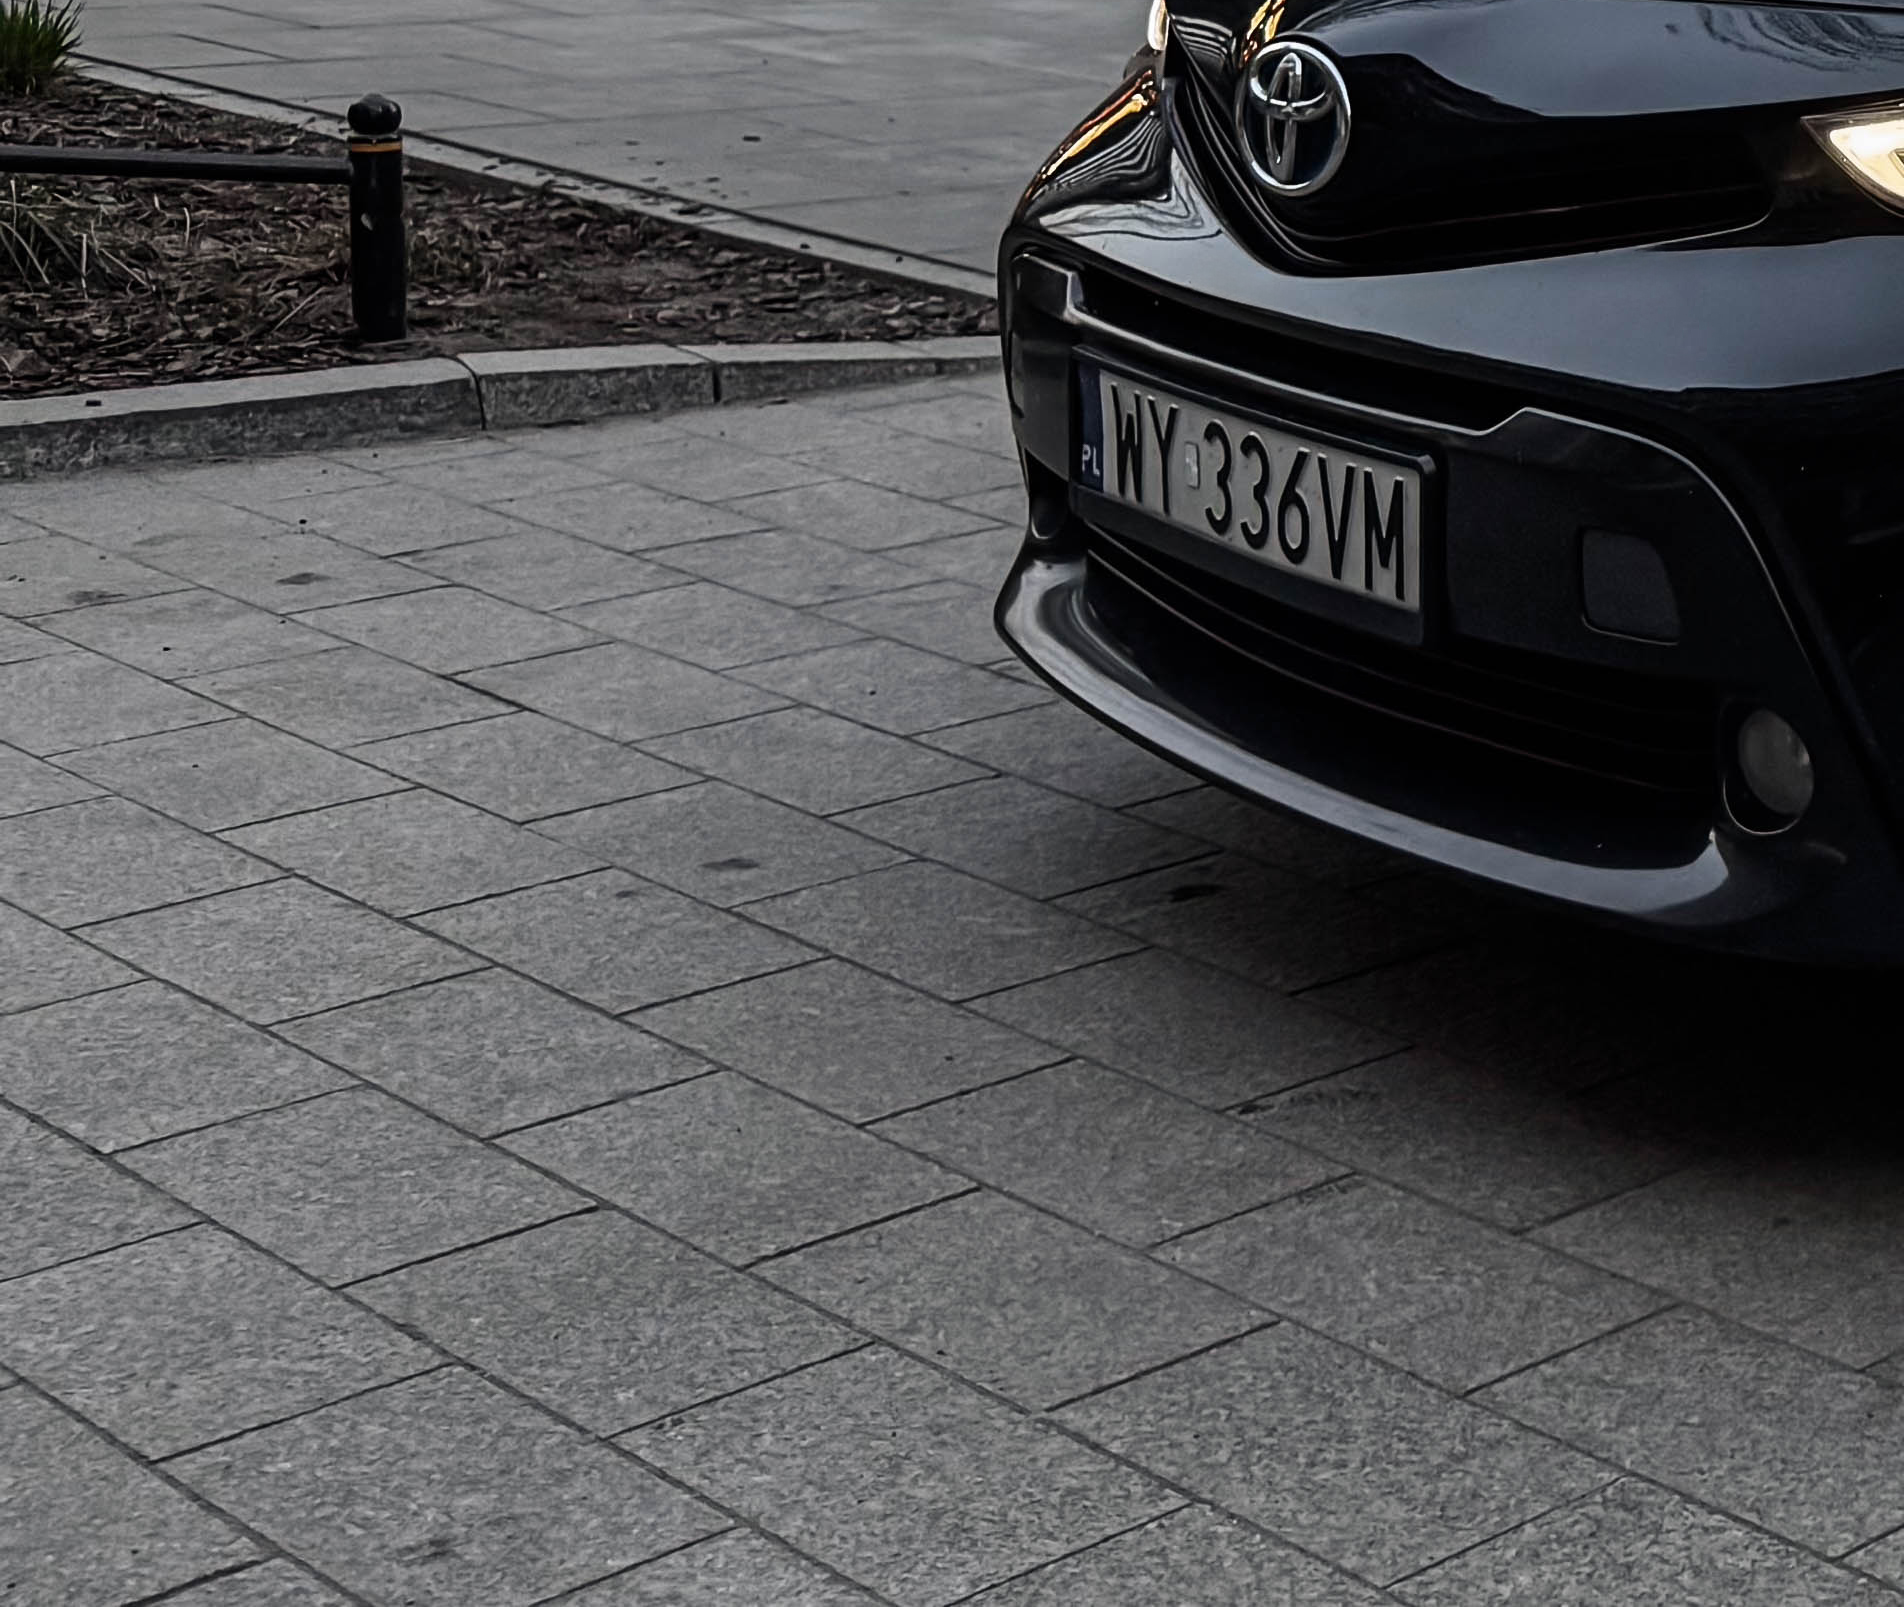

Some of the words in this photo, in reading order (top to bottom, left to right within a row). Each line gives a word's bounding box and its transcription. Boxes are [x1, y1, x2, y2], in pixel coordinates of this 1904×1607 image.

[1081, 444, 1101, 477] PL
[1110, 382, 1180, 517] WY
[1203, 418, 1405, 602] 336VM
